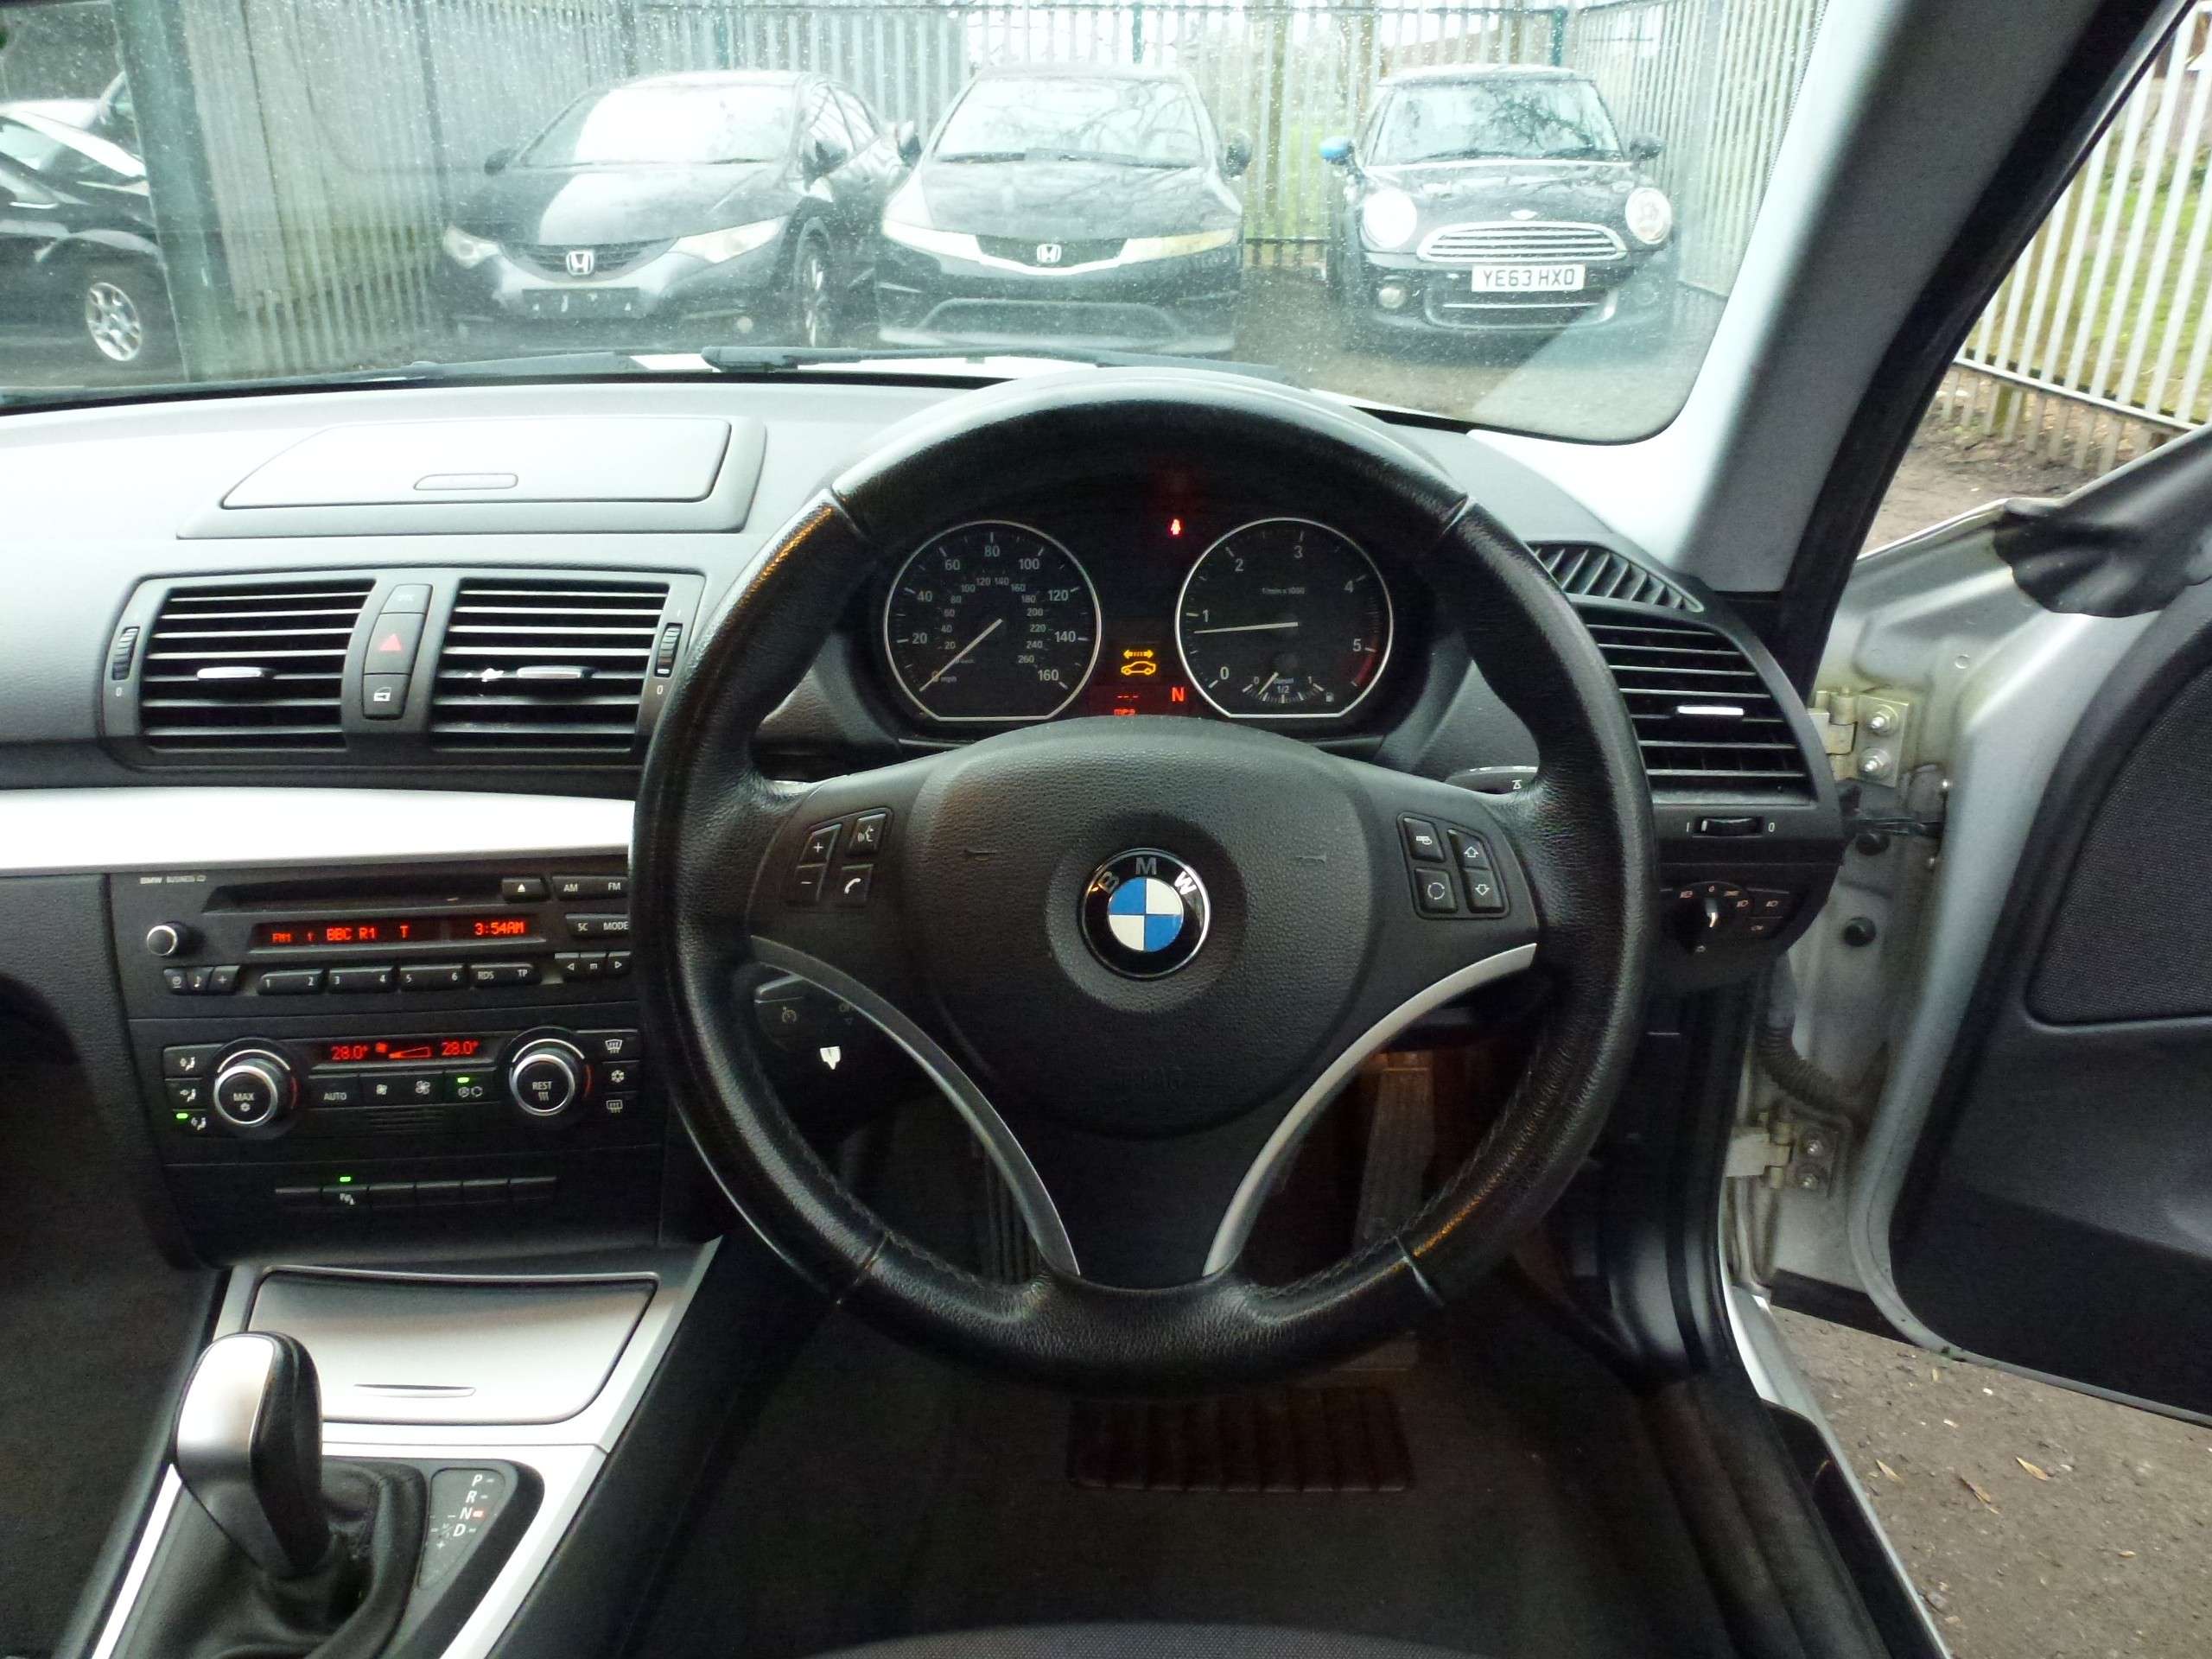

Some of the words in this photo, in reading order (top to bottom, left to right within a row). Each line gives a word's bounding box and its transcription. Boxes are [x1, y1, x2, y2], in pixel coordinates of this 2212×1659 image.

[1483, 269, 1532, 287] YE63
[1538, 268, 1575, 286] HXO
[984, 545, 1001, 557] 80
[1294, 545, 1303, 558] 3
[944, 559, 961, 570] 60
[1018, 558, 1040, 570] 100
[1235, 558, 1244, 572] 2
[1344, 580, 1354, 594] 4
[917, 590, 933, 602] 40
[1048, 589, 1070, 601] 120
[1027, 608, 1044, 617] 200
[1202, 609, 1209, 622] 1
[940, 624, 953, 632] 40
[1029, 624, 1046, 632] 220
[912, 632, 928, 644] 20
[1054, 631, 1076, 642] 140
[944, 641, 956, 650] 20
[1026, 640, 1043, 649] 240
[1352, 639, 1362, 652] 5
[1037, 669, 1059, 681] 160
[1219, 666, 1230, 681] 0
[1172, 687, 1185, 702] N
[1097, 856, 1198, 895] BMW
[563, 883, 578, 892] AM
[607, 882, 621, 891] FM
[327, 927, 353, 941] BBC
[359, 927, 376, 940] R1
[400, 925, 410, 938] T
[475, 921, 525, 936] 3:54AM
[577, 922, 588, 931] SC
[603, 921, 629, 931] MODE
[406, 974, 412, 983] 5
[451, 972, 458, 981] 6
[477, 970, 495, 980] RDS
[518, 969, 528, 977] TP
[266, 979, 270, 988] 1
[308, 976, 314, 986] 2
[334, 976, 340, 985] 3
[379, 975, 386, 983] 4
[531, 1081, 553, 1090] REST
[233, 1092, 255, 1102] MAX
[323, 1091, 347, 1101] AUTO
[472, 1474, 483, 1486] P
[466, 1491, 477, 1503] R
[460, 1507, 473, 1520] N
[453, 1523, 467, 1536] D
